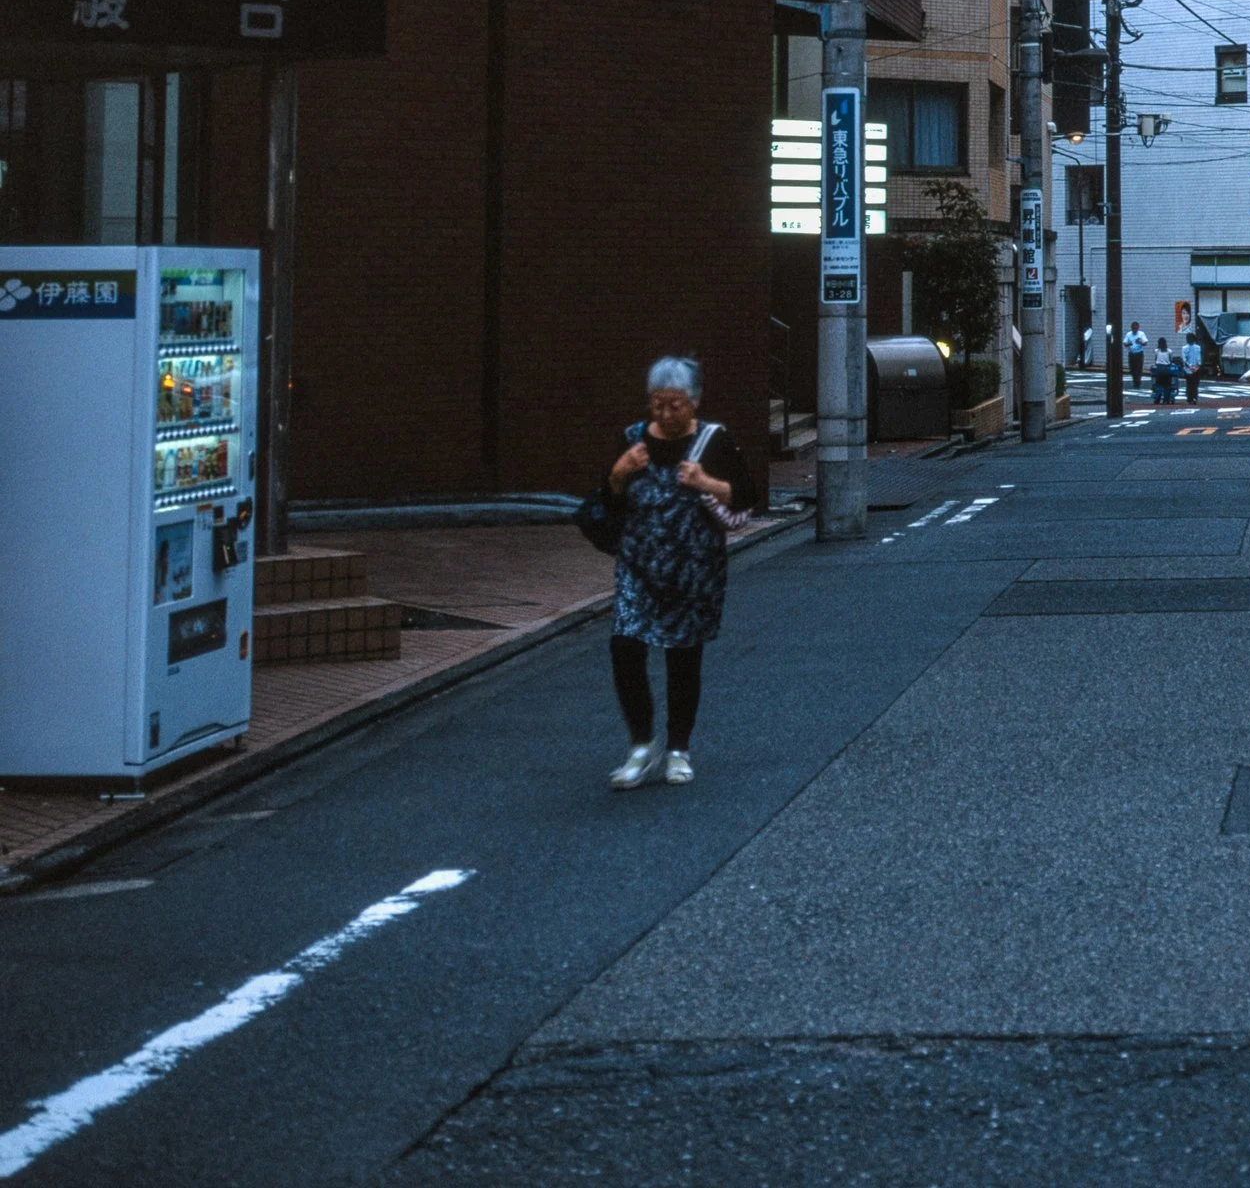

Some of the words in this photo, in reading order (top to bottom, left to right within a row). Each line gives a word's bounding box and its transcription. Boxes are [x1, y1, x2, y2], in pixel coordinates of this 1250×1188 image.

[832, 130, 849, 226] 東急リバブル
[36, 279, 119, 306] 伊藤園
[828, 290, 853, 299] 3-28
